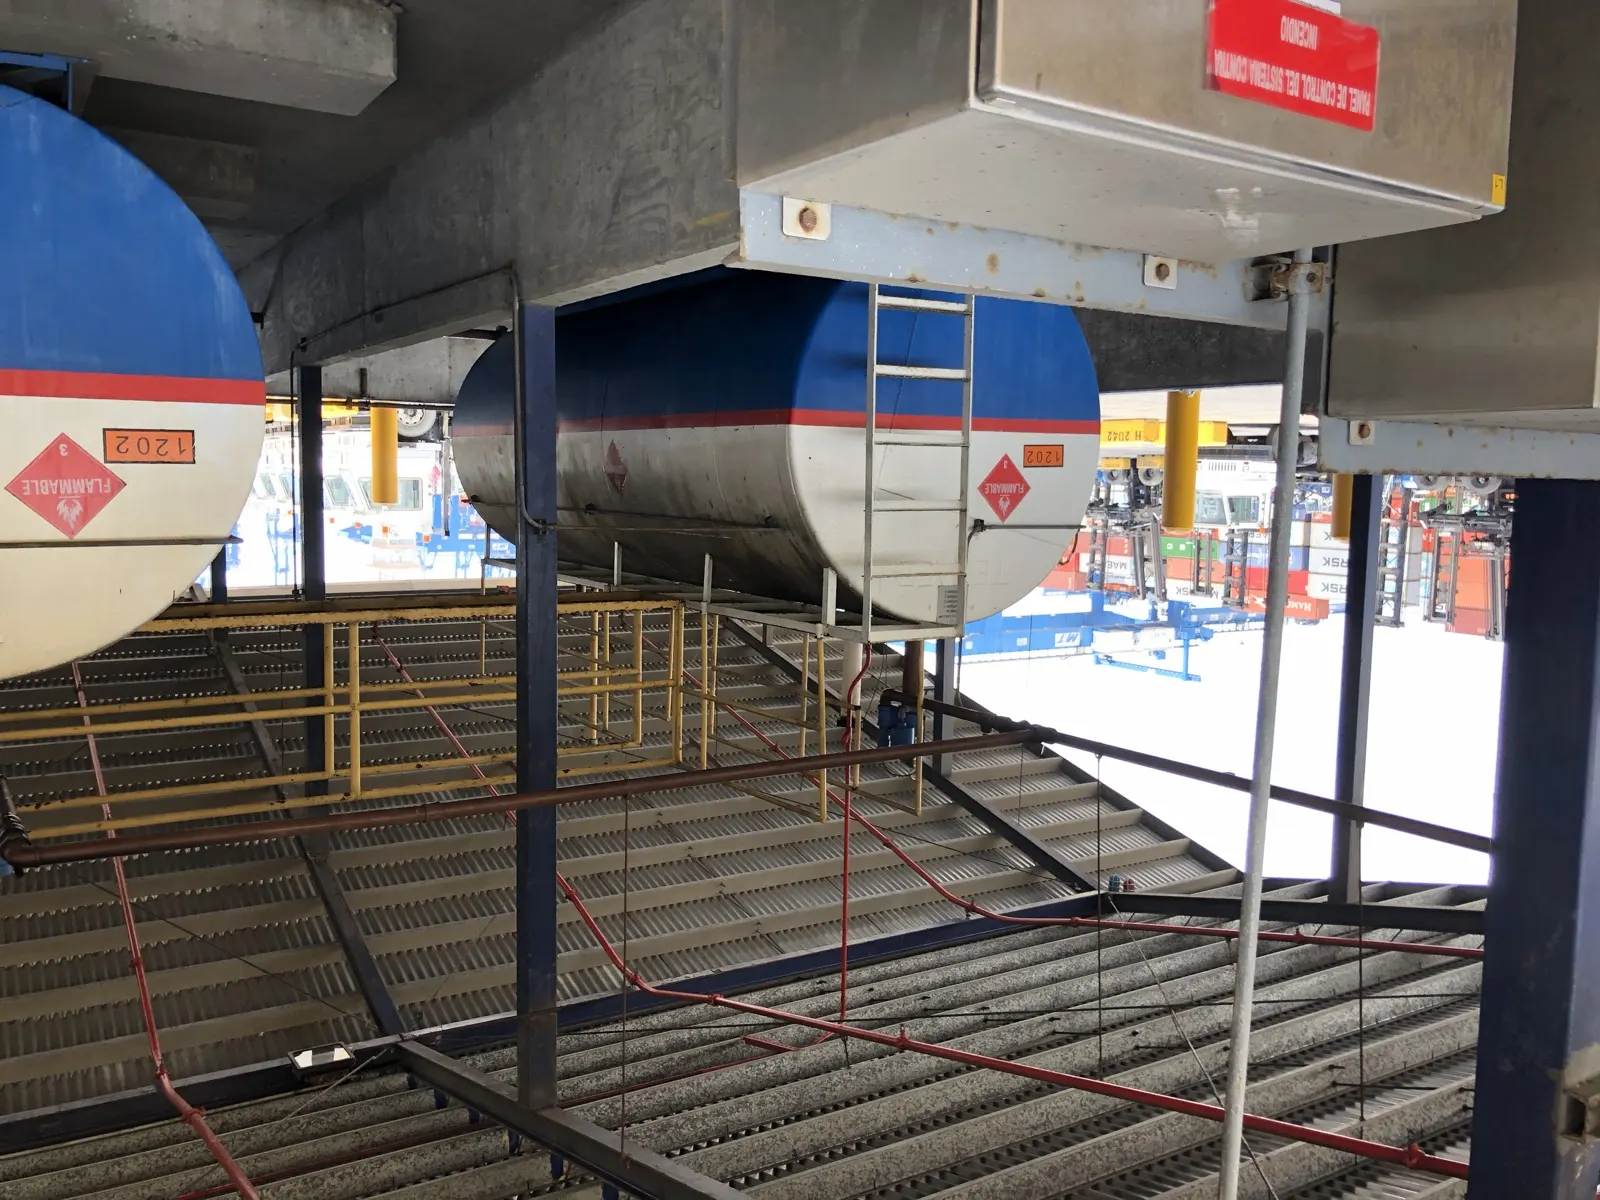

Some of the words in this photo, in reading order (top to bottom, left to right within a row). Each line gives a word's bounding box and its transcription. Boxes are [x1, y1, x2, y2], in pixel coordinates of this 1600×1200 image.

[1280, 15, 1318, 50] INCENDIO
[1214, 48, 1247, 83] CONTRA
[1249, 59, 1283, 93] SISTEMA
[1285, 69, 1299, 97] DEL
[1301, 73, 1336, 107] CONTROL
[1336, 84, 1347, 110] DE
[1349, 87, 1371, 116] PANEL
[58, 443, 68, 457] 3
[115, 435, 187, 457] 1202
[1026, 450, 1060, 464] 1202
[21, 478, 112, 496] FLAMMABLE
[984, 483, 1025, 494] FLAMMABLE
